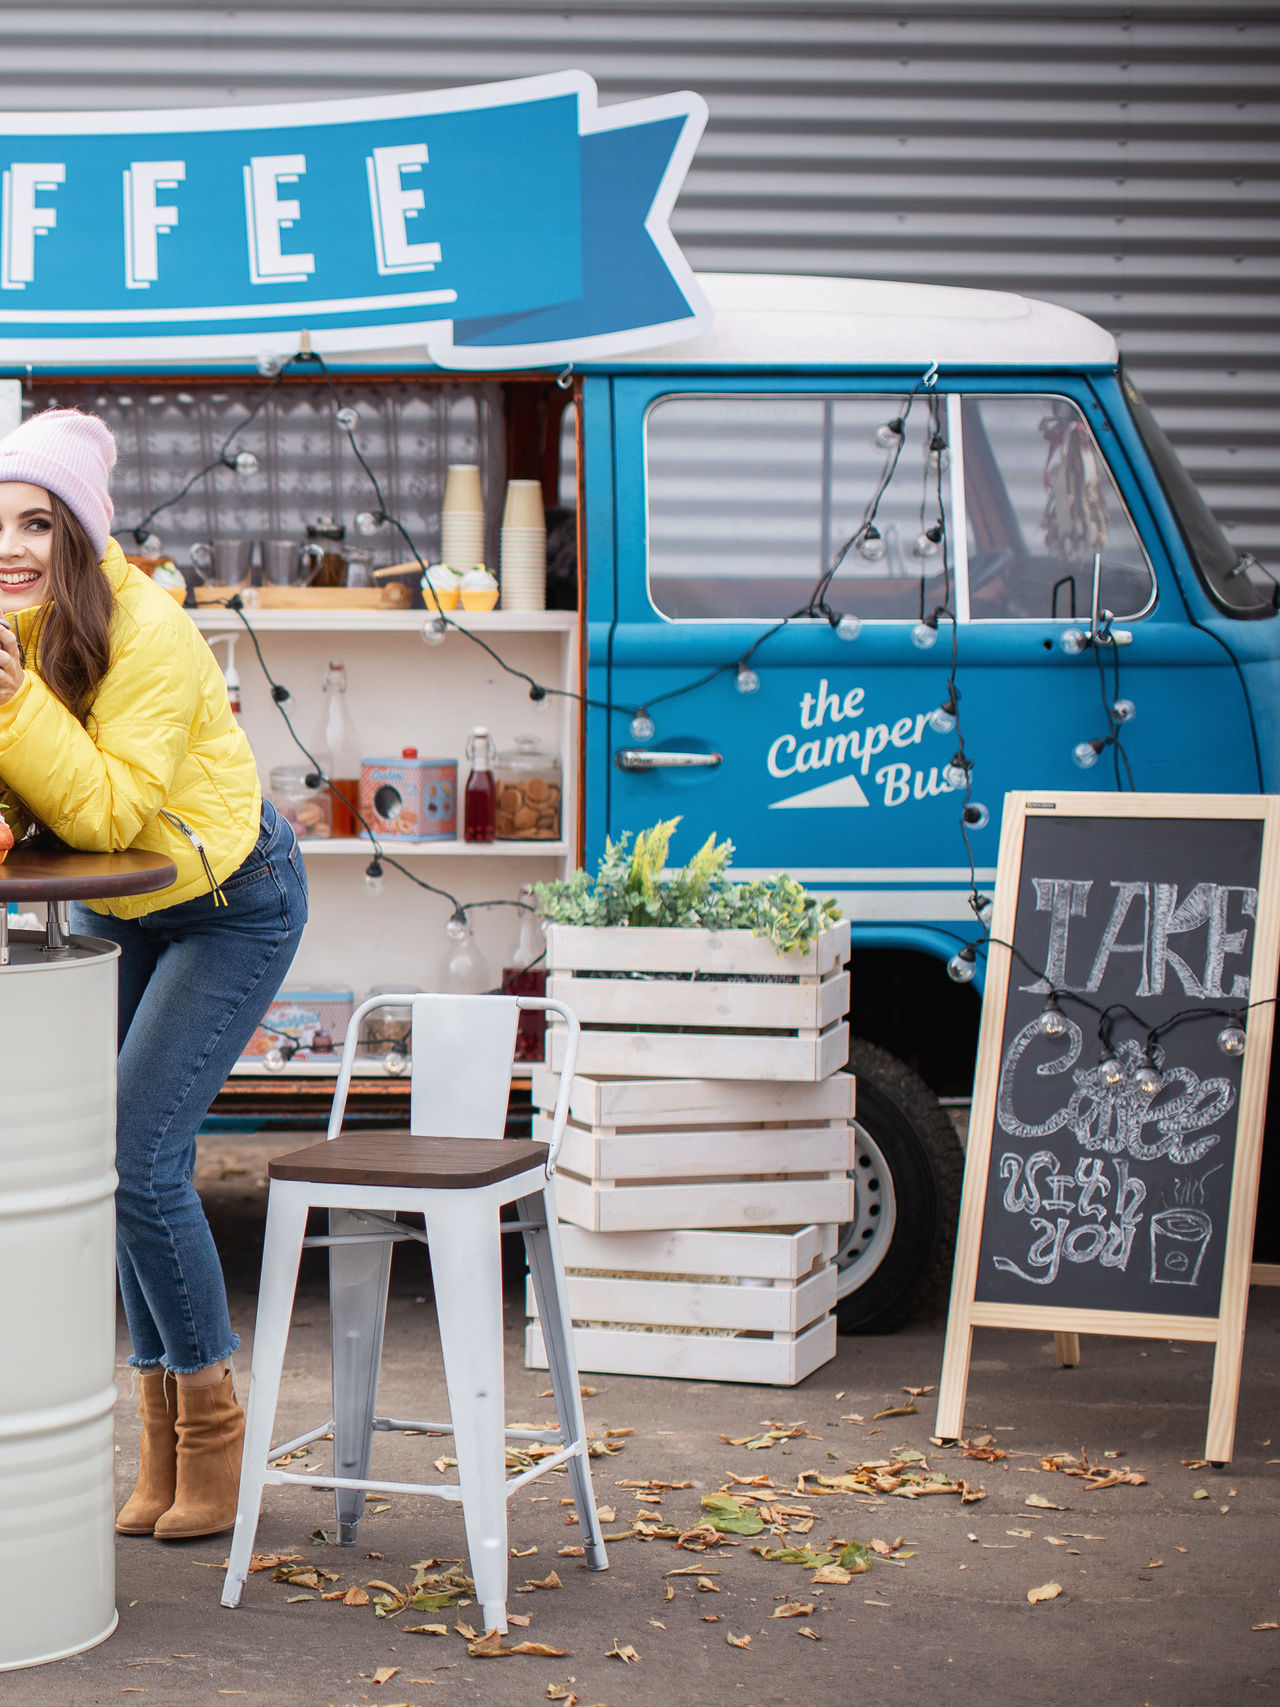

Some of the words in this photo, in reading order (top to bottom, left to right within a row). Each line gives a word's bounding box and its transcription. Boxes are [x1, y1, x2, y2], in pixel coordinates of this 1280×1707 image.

[799, 678, 865, 730] the
[767, 711, 933, 778] Camper
[1019, 877, 1260, 999] TAKE
